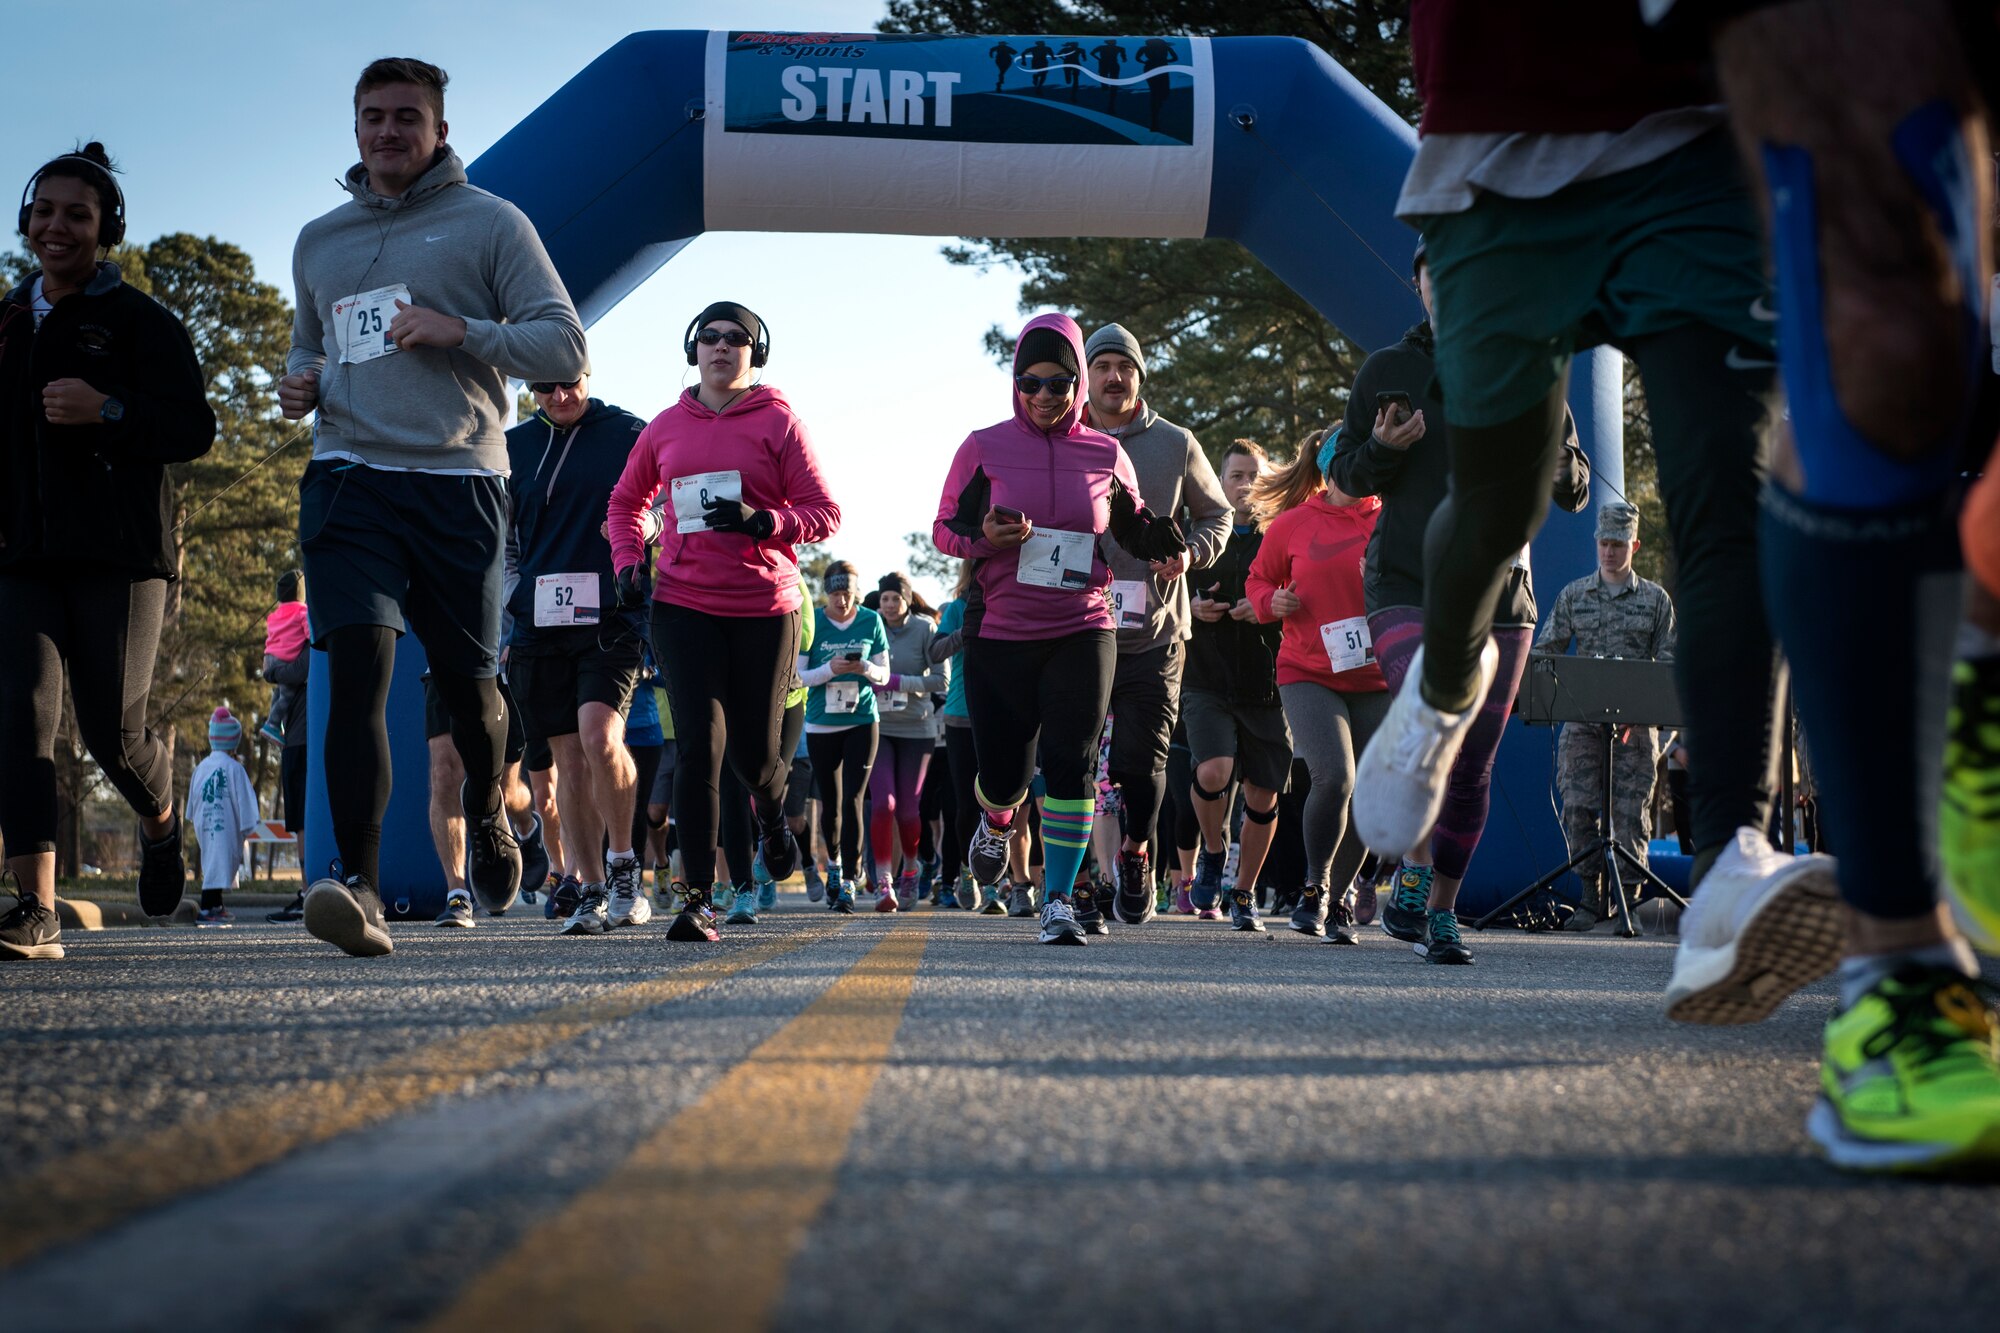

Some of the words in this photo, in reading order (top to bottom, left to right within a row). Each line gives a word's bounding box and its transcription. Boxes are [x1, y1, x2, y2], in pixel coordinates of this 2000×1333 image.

[735, 32, 833, 44] Fitness
[757, 44, 774, 56] &
[781, 43, 868, 59] Sports
[781, 65, 961, 127] START
[358, 307, 383, 336] 25
[700, 488, 709, 507] 8
[1050, 545, 1060, 566] 4
[555, 586, 573, 606] 52
[1111, 592, 1123, 610] 9
[1345, 630, 1362, 650] 51
[837, 690, 842, 701] 2
